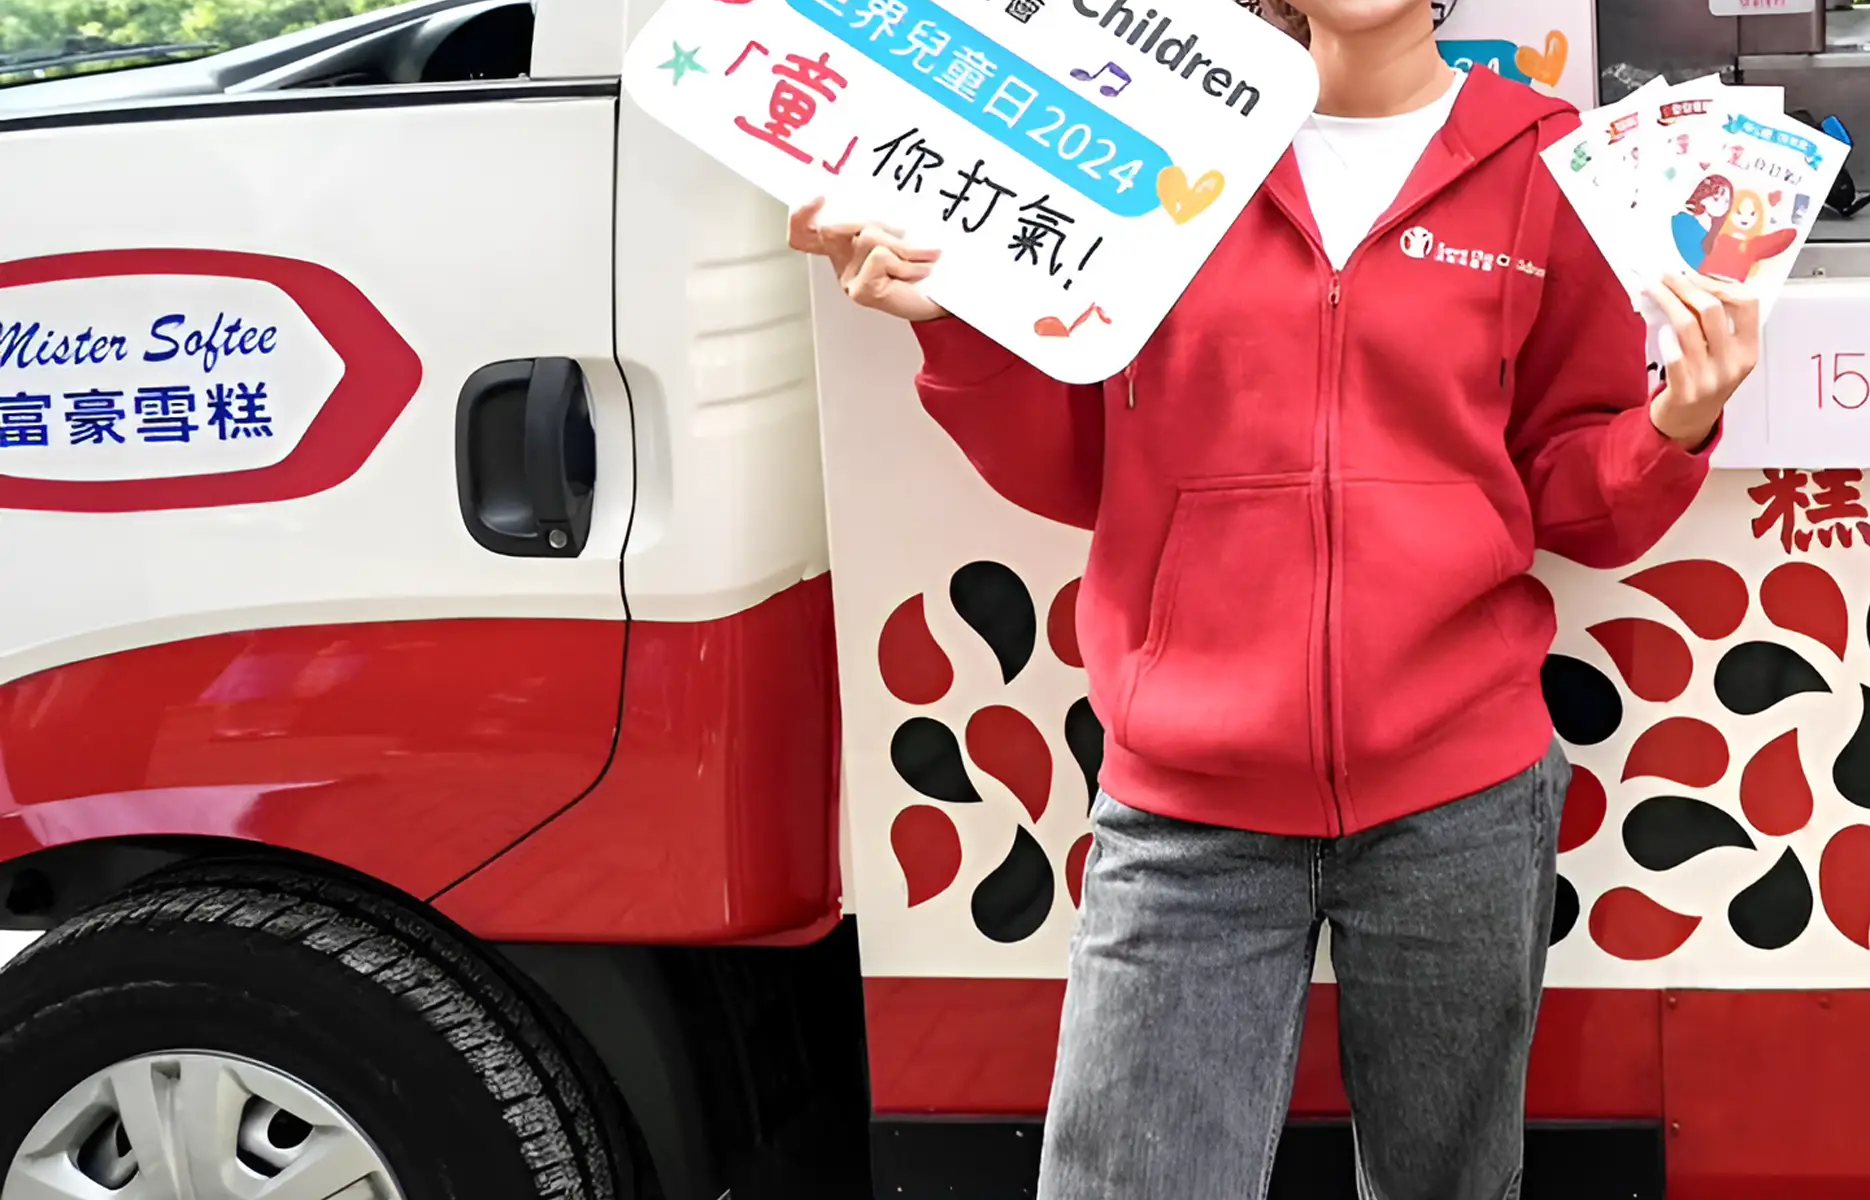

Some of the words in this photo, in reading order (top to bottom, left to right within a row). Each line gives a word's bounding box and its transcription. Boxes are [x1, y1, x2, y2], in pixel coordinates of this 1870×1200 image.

[0, 321, 128, 369] Mister
[143, 312, 277, 373] Softee
[1810, 352, 1870, 411] 15
[0, 381, 274, 448] 富豪雪糕
